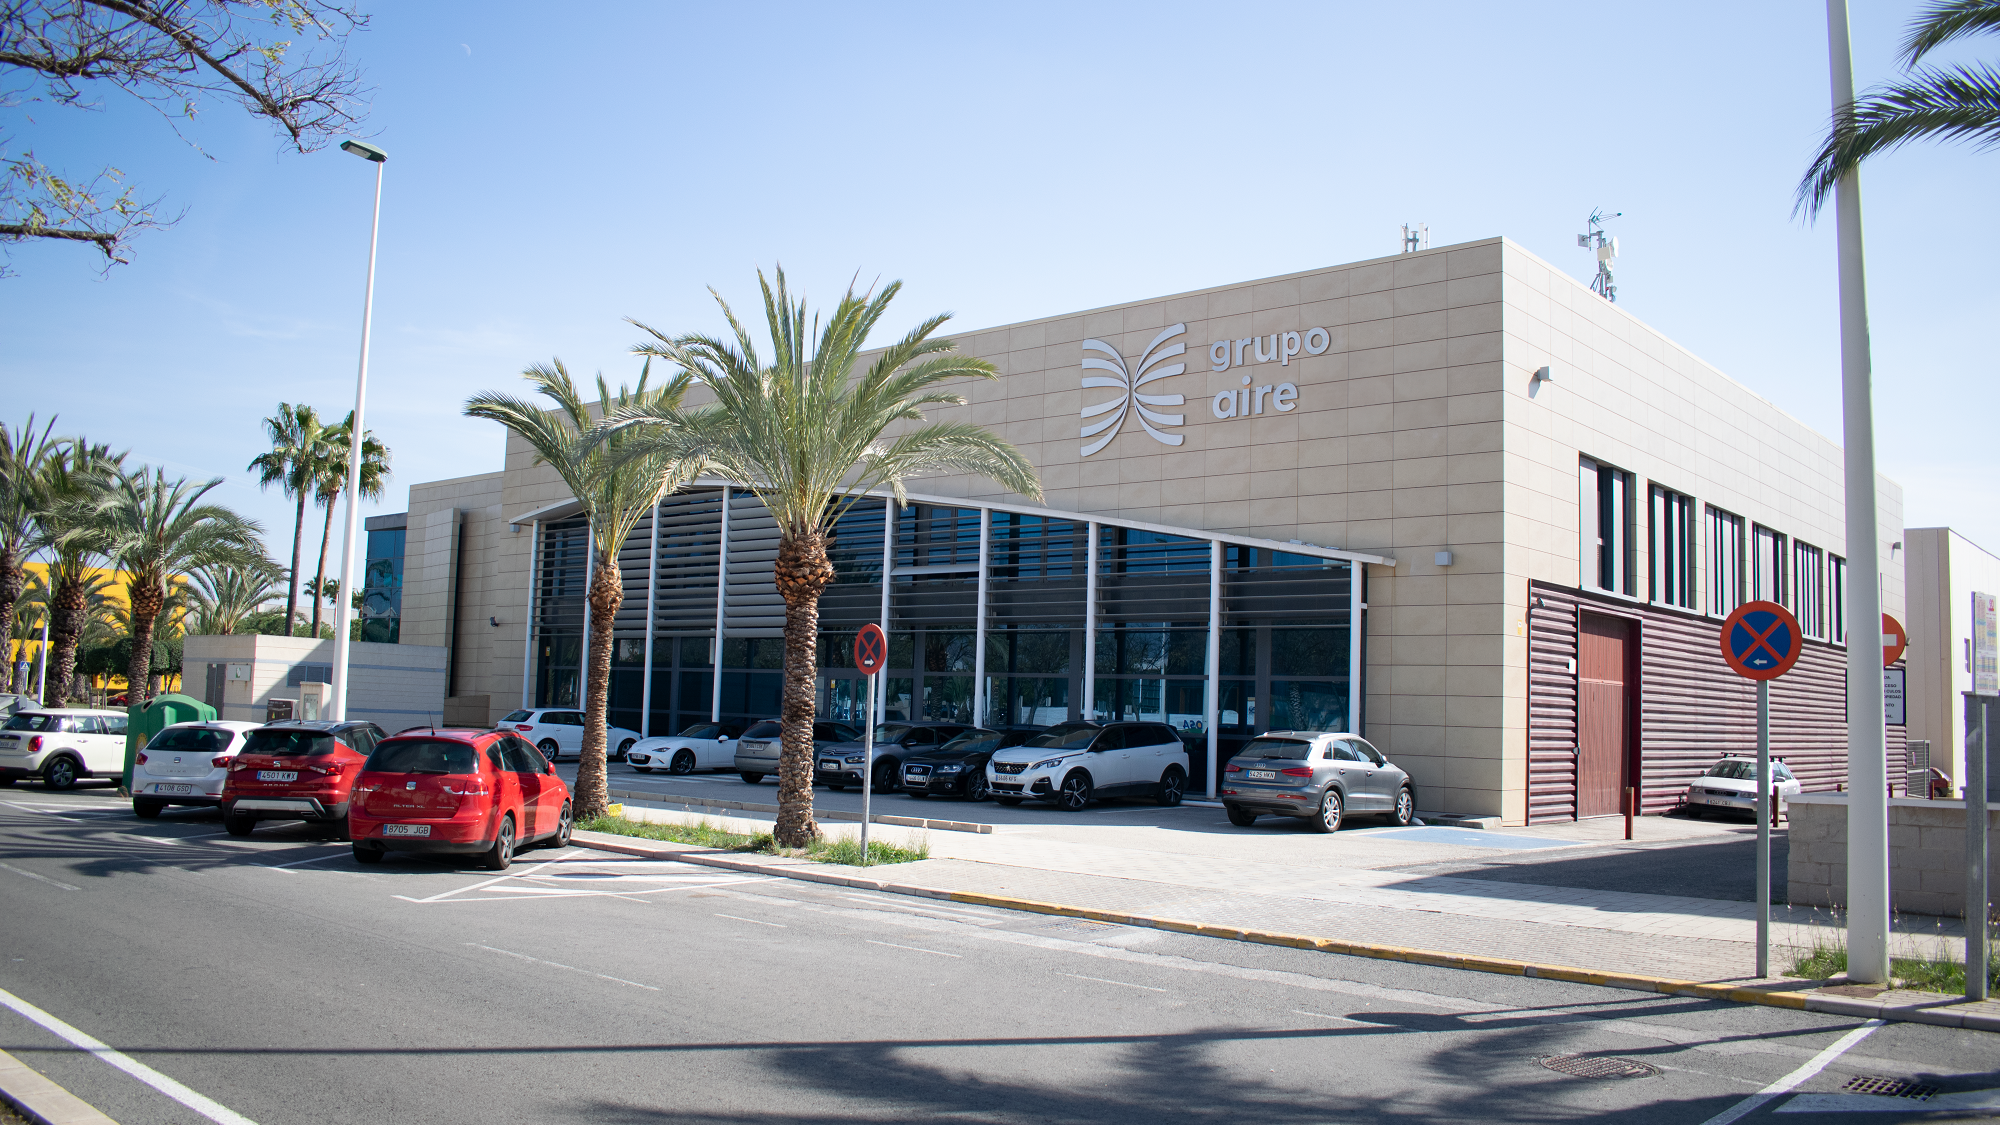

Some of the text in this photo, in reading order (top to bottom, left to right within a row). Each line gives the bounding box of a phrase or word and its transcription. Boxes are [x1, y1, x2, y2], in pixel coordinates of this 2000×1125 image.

[1209, 326, 1331, 372] grupo
[1212, 375, 1299, 419] aire
[388, 825, 429, 835] 8705 JGB
